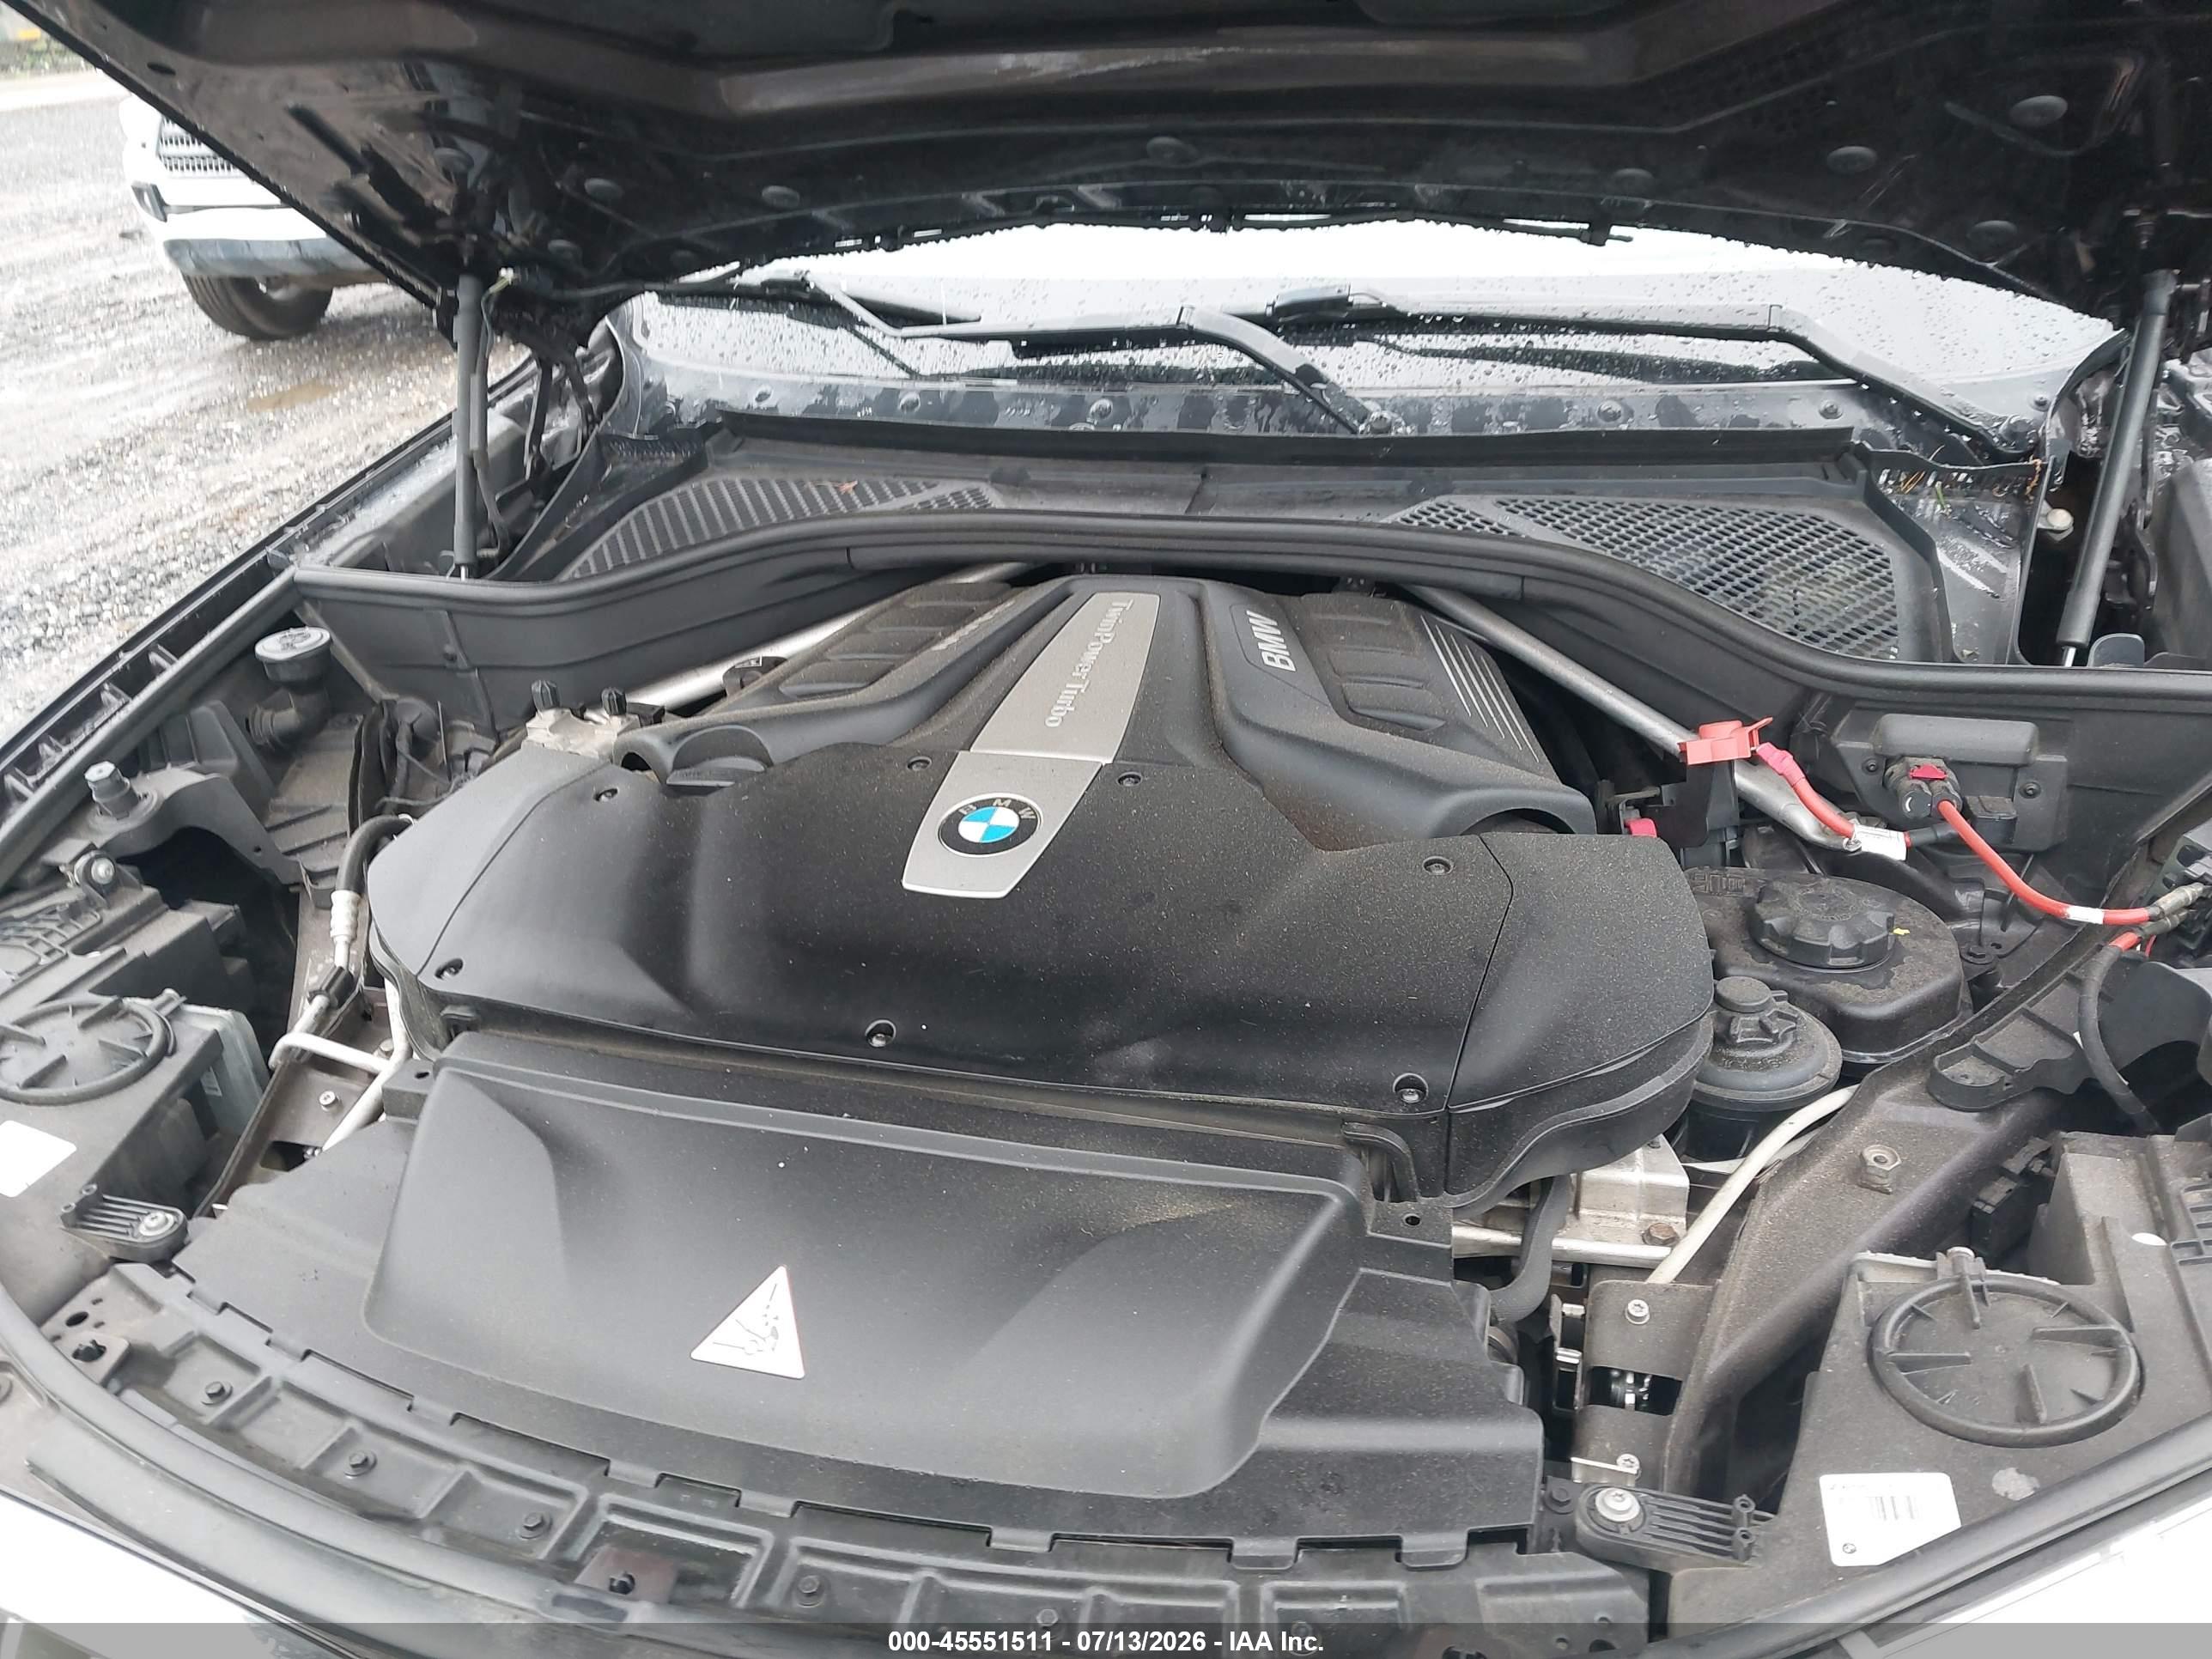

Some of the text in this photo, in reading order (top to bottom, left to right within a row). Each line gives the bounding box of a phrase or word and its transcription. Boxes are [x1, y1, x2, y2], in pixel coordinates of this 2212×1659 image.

[1044, 599, 1134, 727] TwinPower Turbo
[1245, 610, 1297, 672] BMW
[958, 798, 1036, 819] BMW
